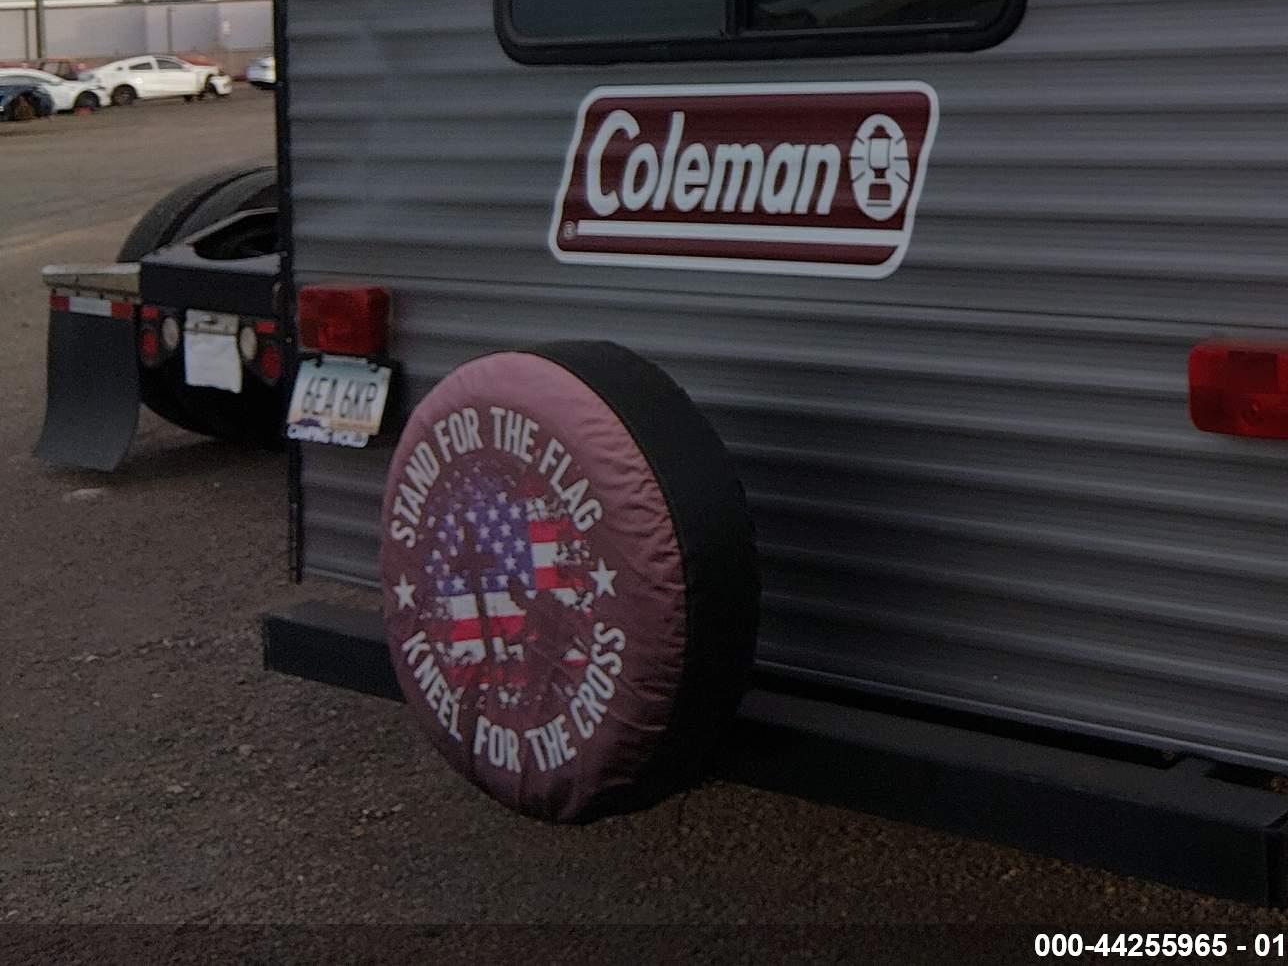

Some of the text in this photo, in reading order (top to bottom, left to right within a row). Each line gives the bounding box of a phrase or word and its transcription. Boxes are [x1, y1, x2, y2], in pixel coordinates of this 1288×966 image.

[586, 109, 842, 218] Coleman
[391, 406, 603, 548] STAND FOR THE FLAG
[402, 622, 626, 773] KNEEL FOR THE CROSS
